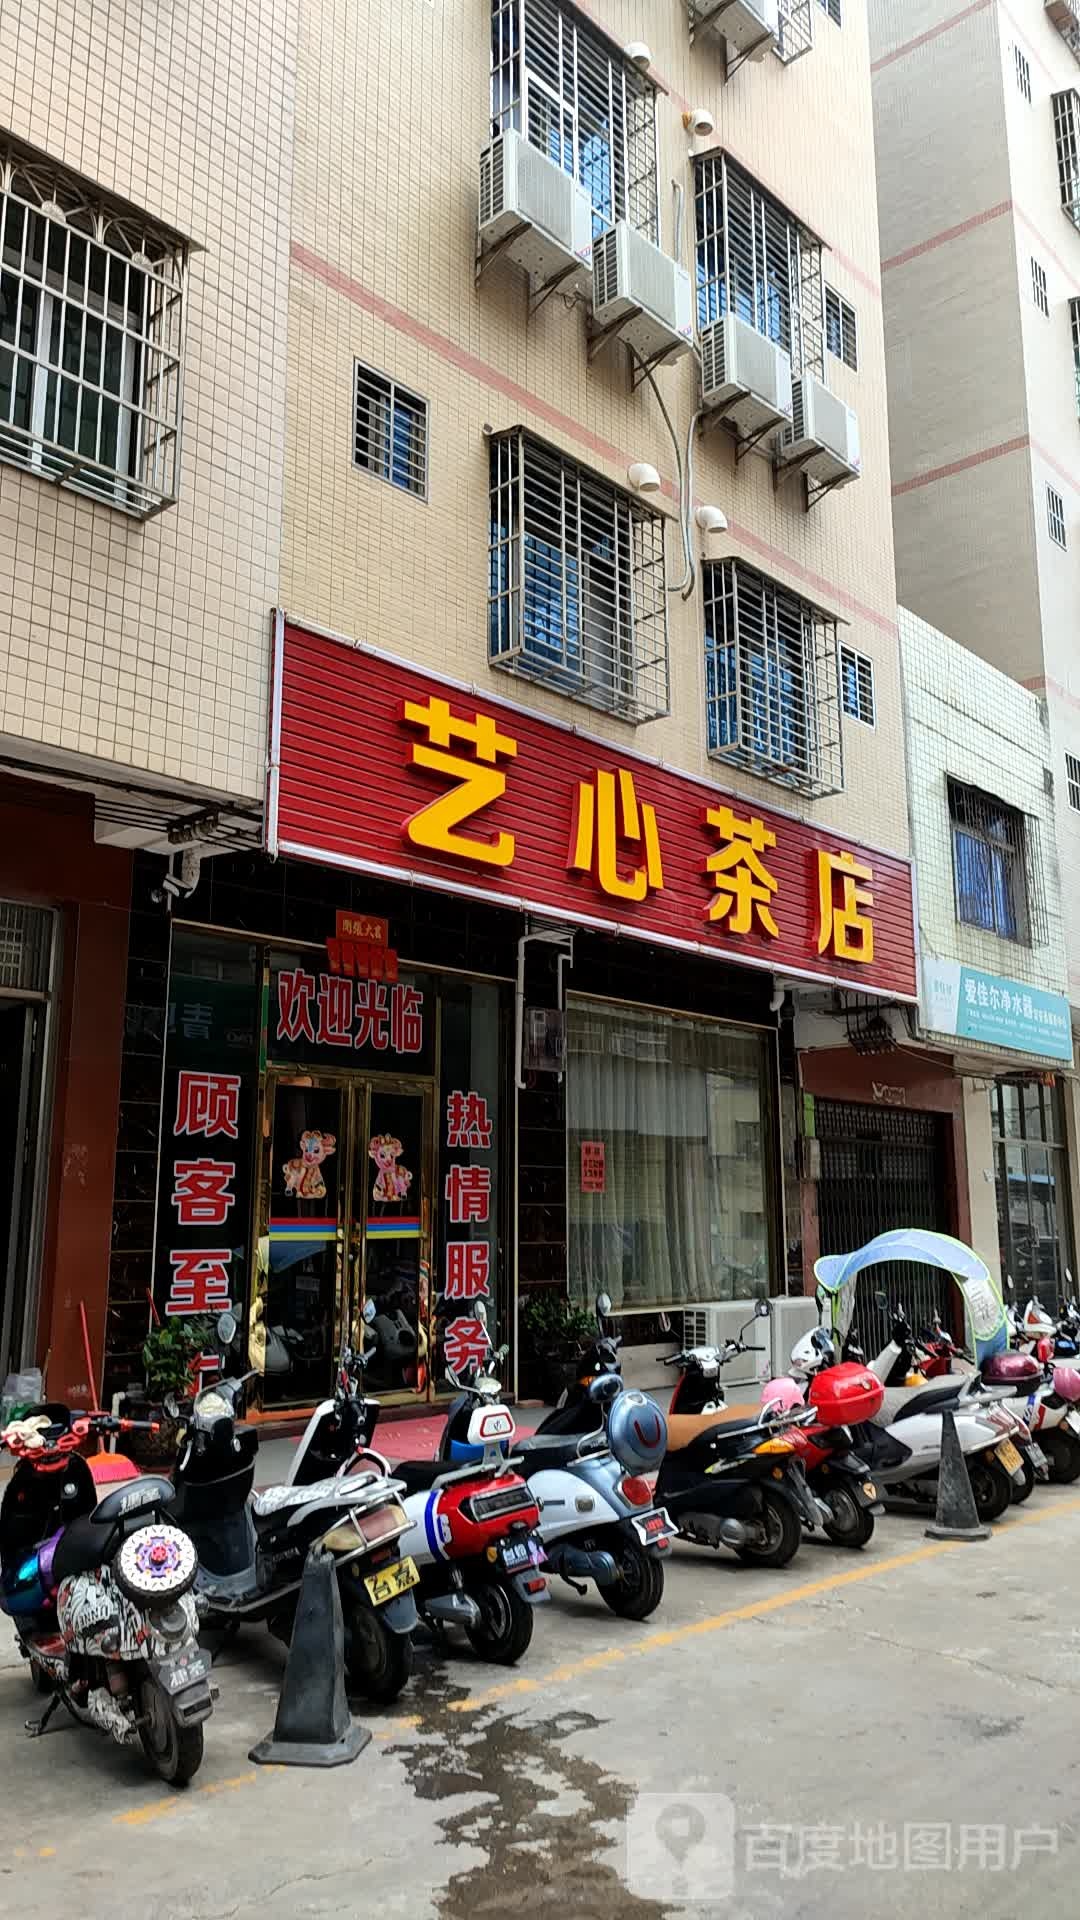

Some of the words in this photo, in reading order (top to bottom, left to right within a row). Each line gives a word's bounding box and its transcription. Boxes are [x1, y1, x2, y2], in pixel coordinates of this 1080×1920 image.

[401, 697, 875, 965] 艺心茶店
[277, 968, 424, 1054] 欢迎光临
[444, 1090, 493, 1376] 热情服务
